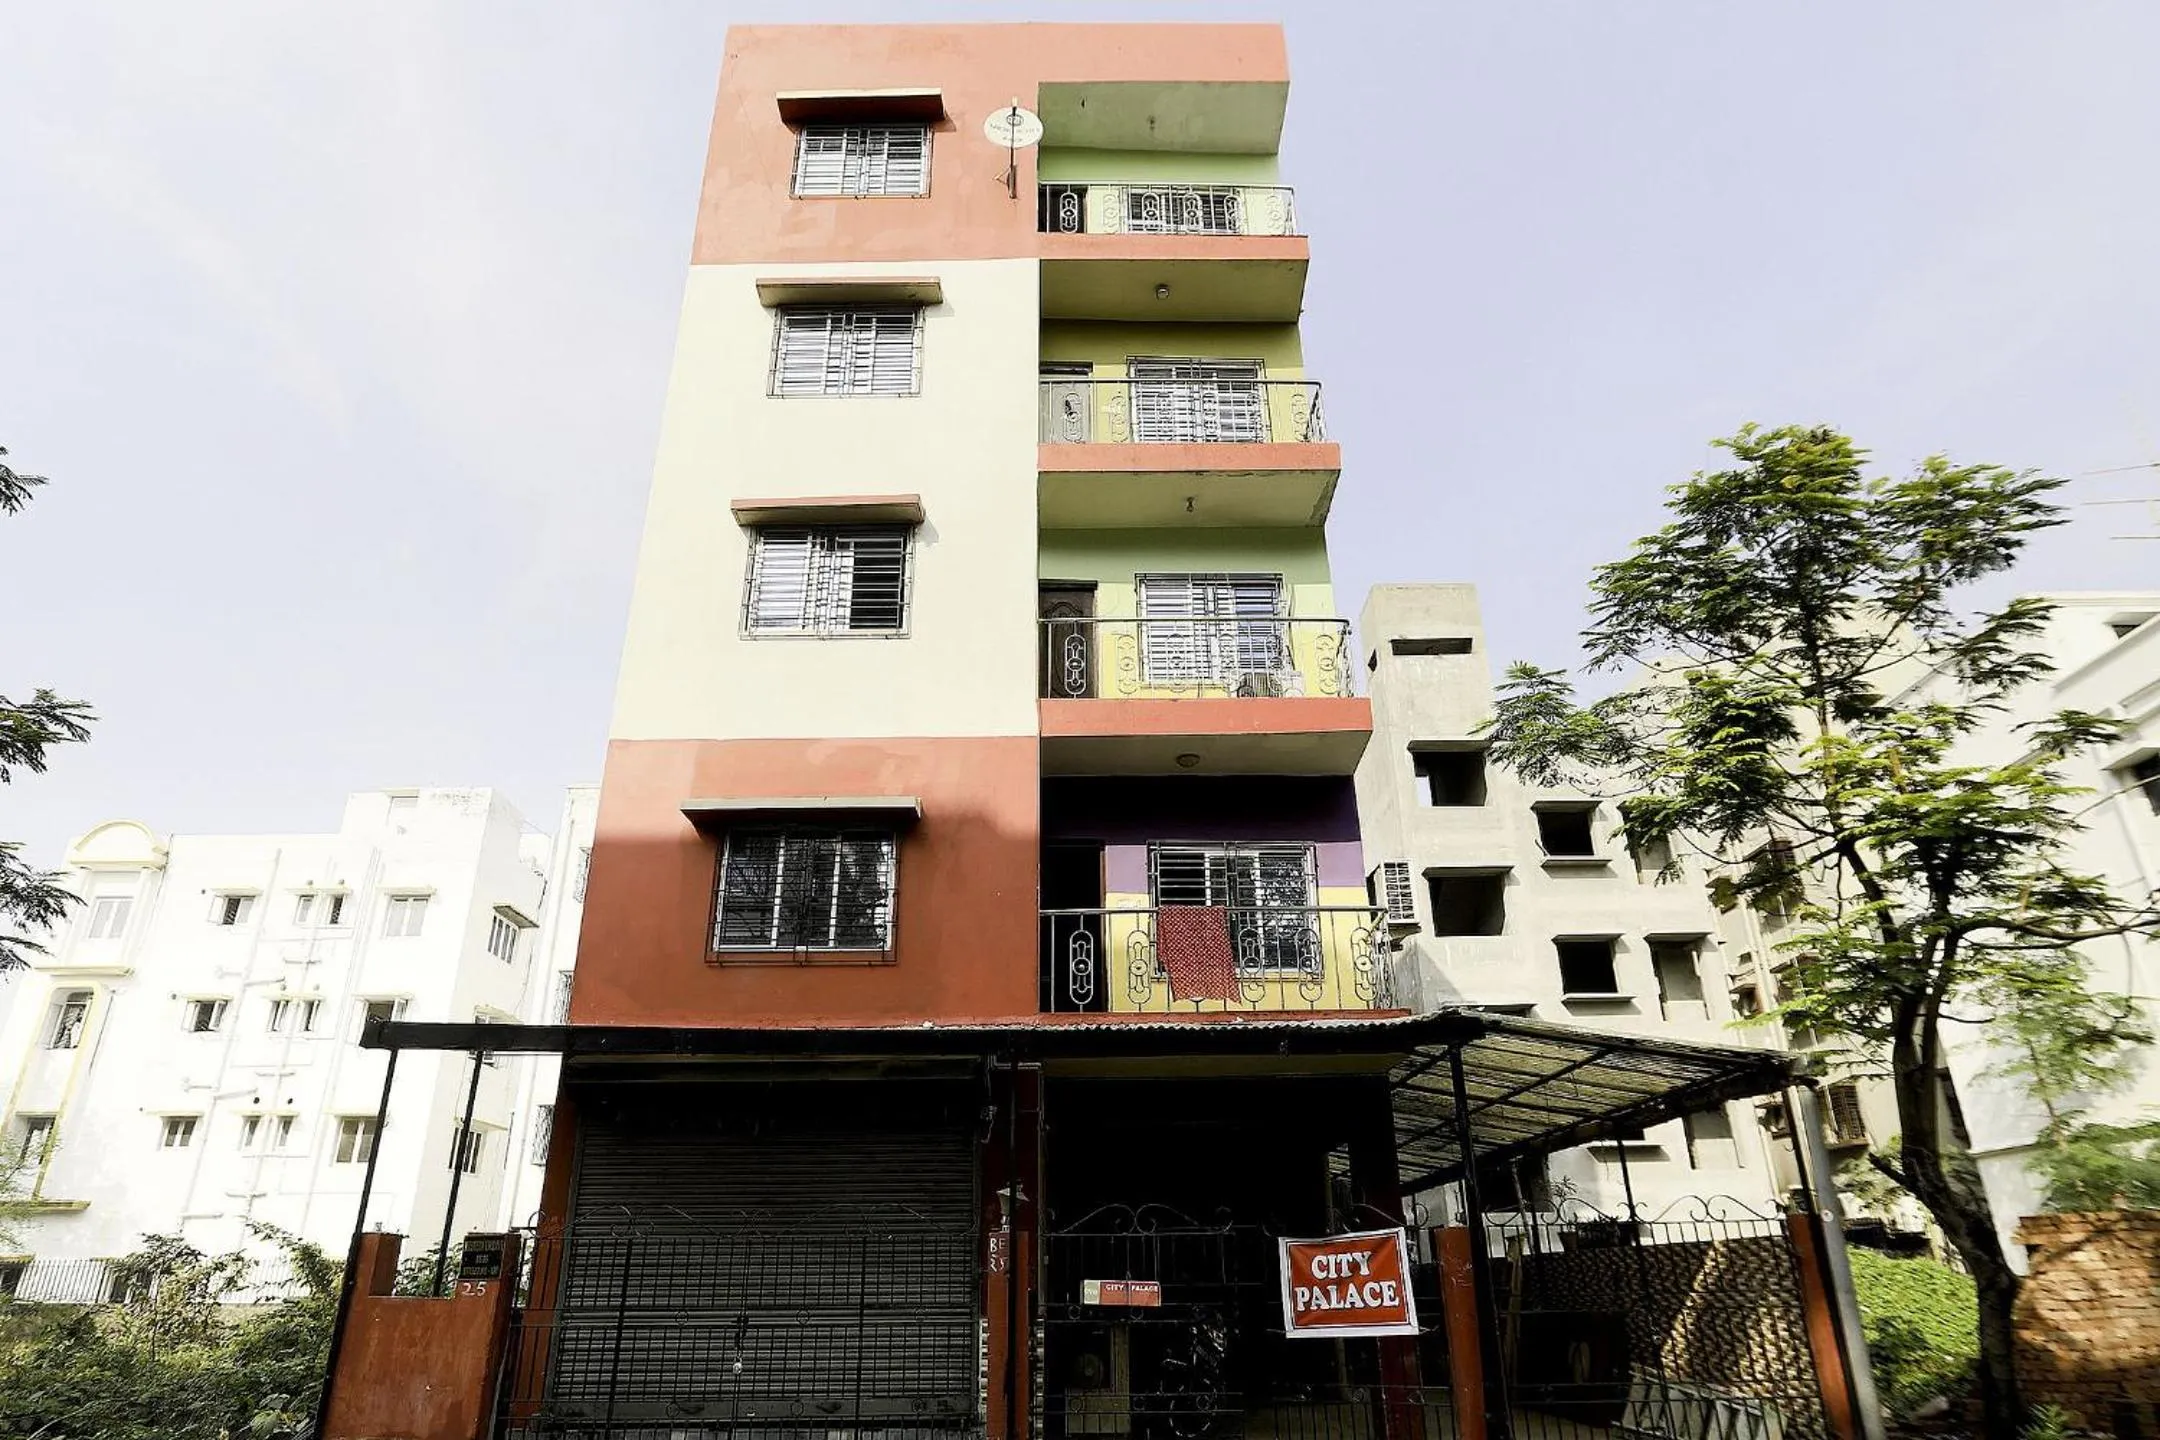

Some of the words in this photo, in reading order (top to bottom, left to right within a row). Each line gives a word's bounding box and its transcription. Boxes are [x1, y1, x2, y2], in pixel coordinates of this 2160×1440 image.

[1311, 1250, 1372, 1280] CITY
[461, 1281, 488, 1297] 25
[1105, 1284, 1124, 1292] CITY
[1131, 1284, 1158, 1292] PALACE
[1294, 1279, 1400, 1312] PALACE
